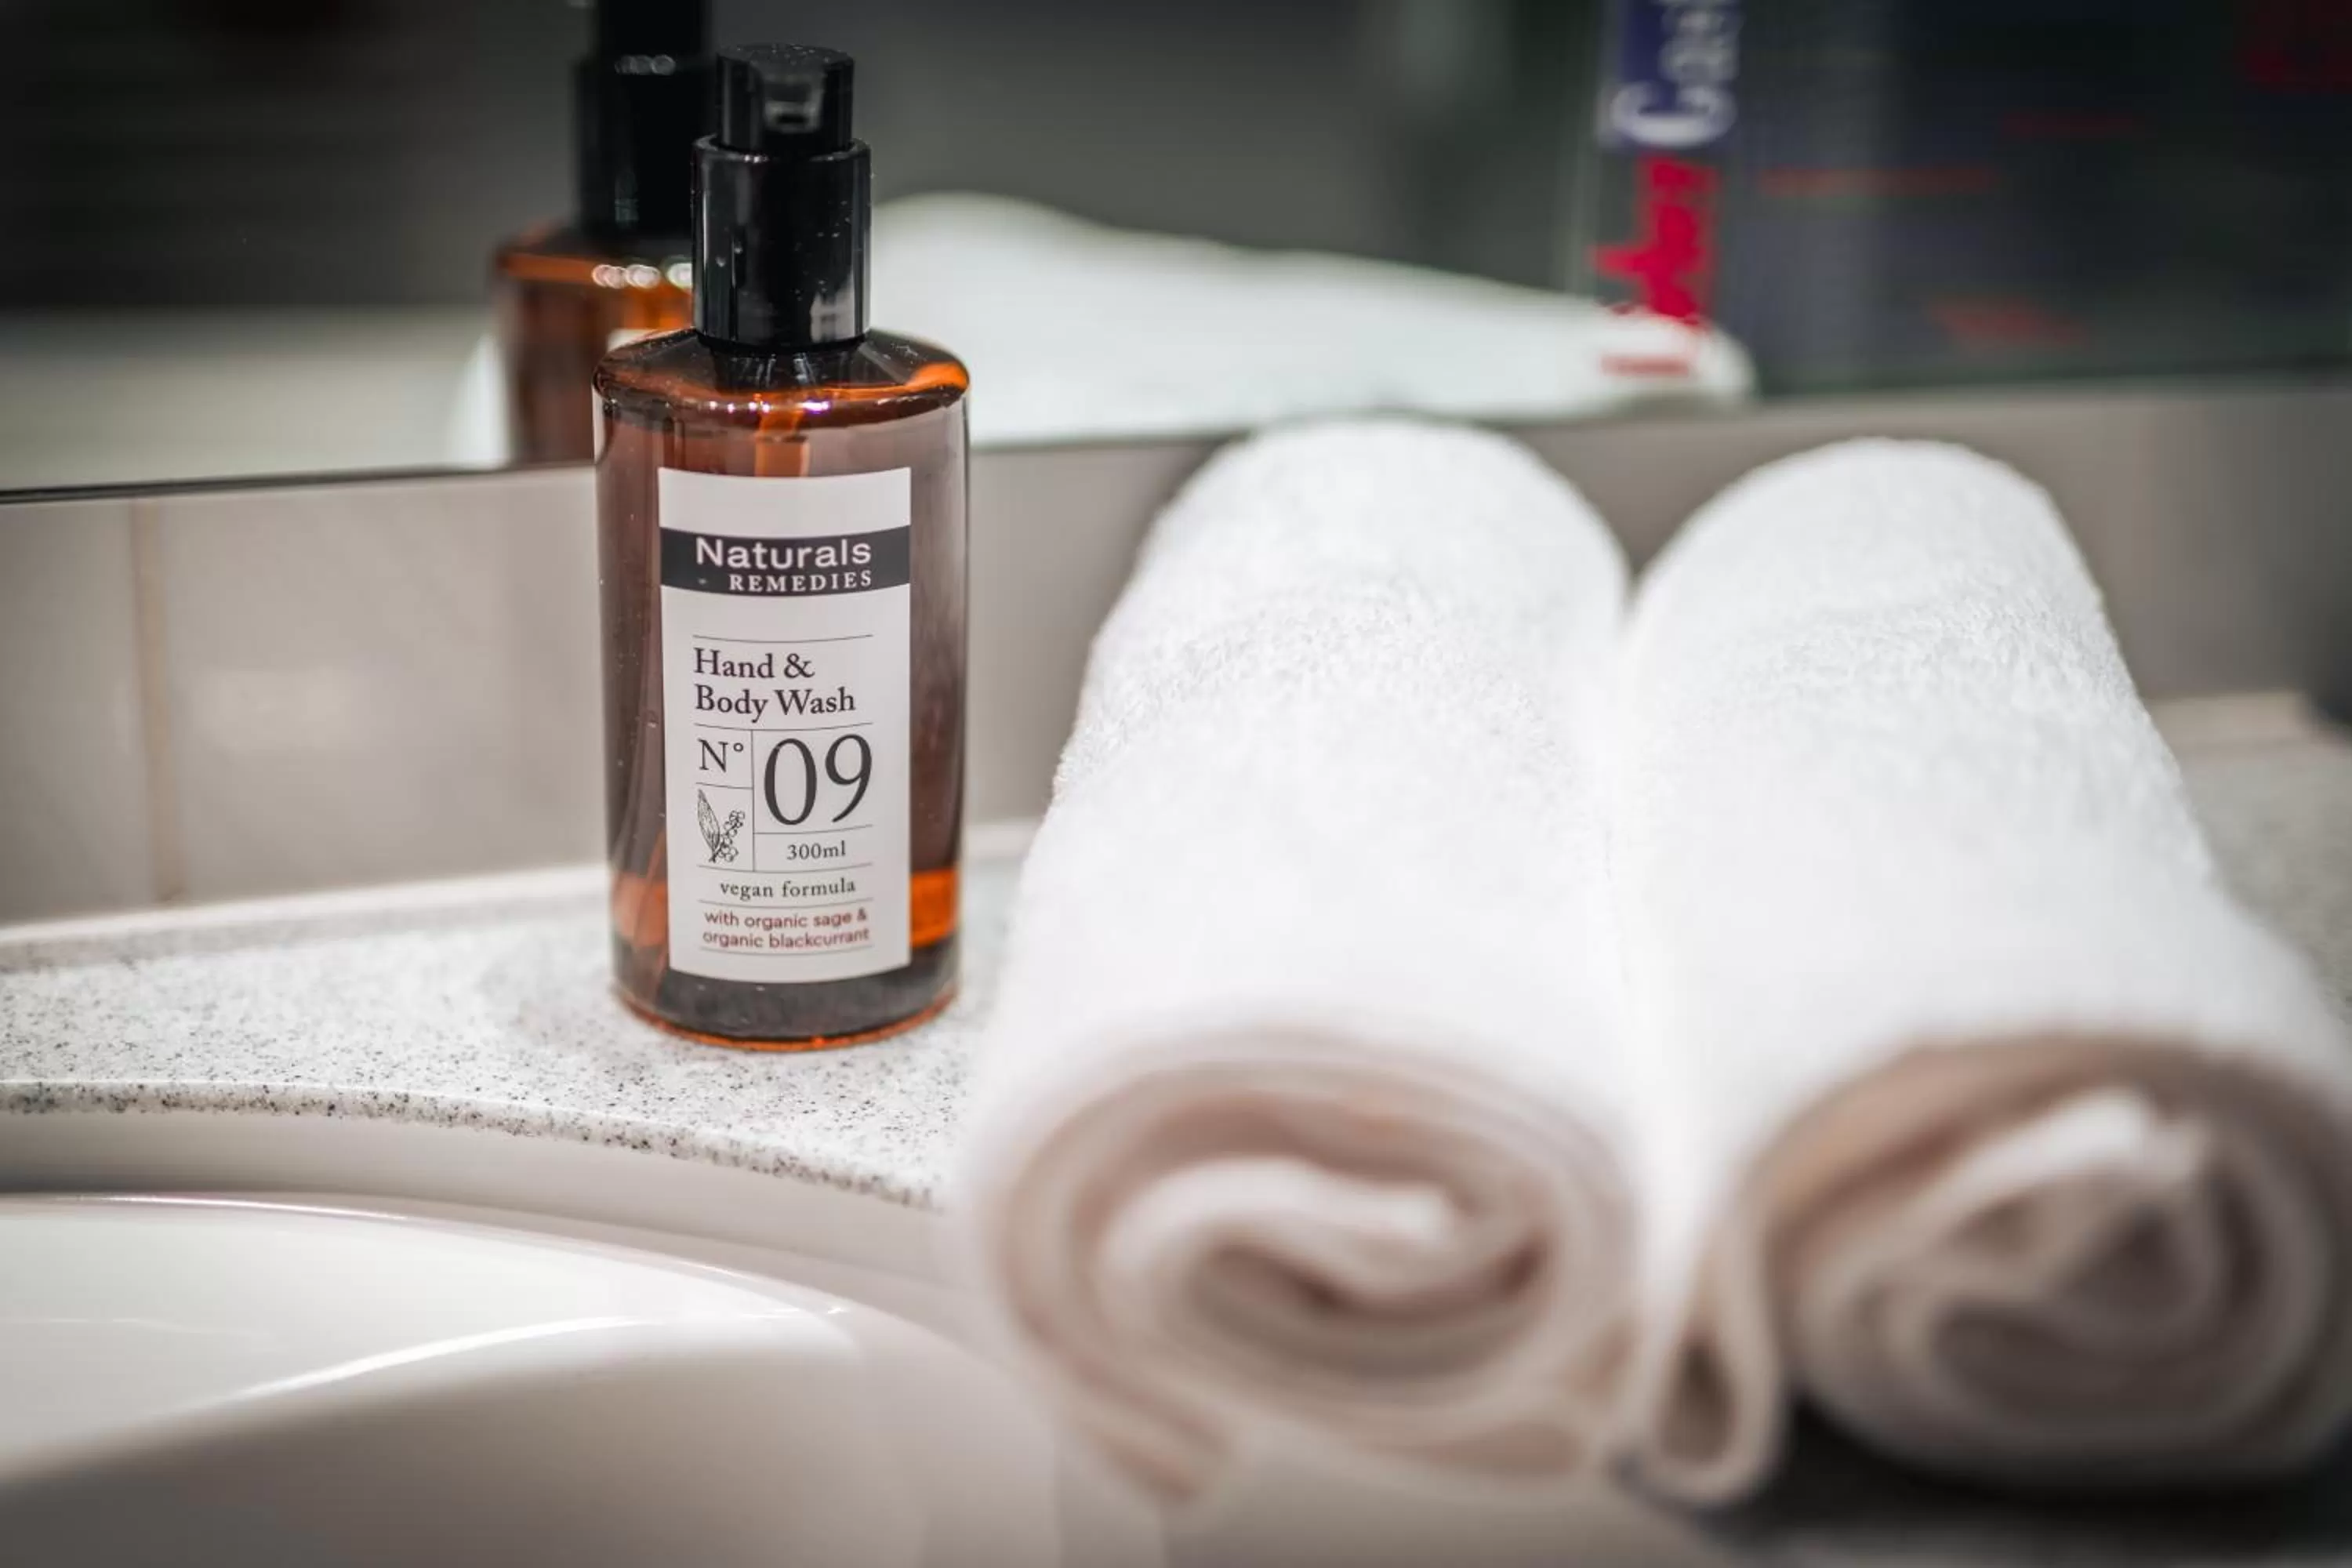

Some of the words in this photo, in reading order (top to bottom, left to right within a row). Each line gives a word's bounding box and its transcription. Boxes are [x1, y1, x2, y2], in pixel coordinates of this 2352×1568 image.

[695, 536, 872, 569] Naturals
[729, 570, 872, 593] REMEDIES
[693, 648, 775, 679] Hand
[783, 653, 816, 678] &
[695, 684, 768, 724] Body
[775, 687, 856, 715] Wash
[764, 734, 873, 826] 09
[786, 840, 846, 861] 300ml
[720, 882, 774, 901] vegan
[782, 877, 856, 898] formula
[704, 910, 739, 927] with
[743, 914, 808, 931] organic
[813, 912, 852, 927] sage
[856, 906, 867, 922] &
[702, 931, 764, 948] organic
[769, 928, 869, 948] blackcurrant
